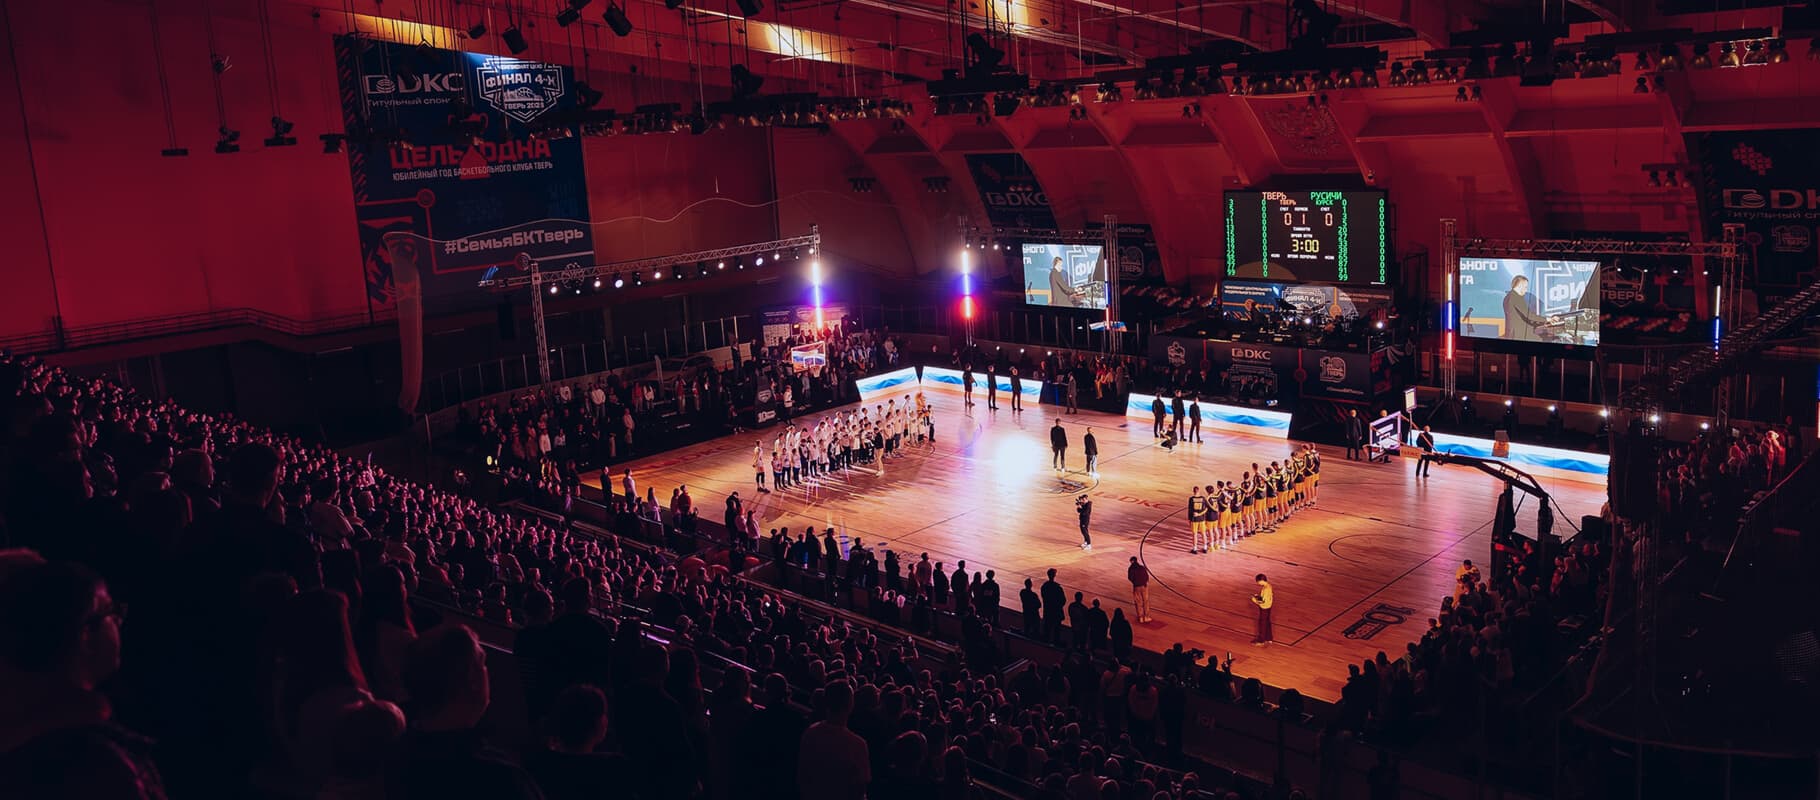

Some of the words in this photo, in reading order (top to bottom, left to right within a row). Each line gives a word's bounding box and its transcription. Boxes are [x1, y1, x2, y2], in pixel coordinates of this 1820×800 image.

[397, 73, 464, 94] DKC
[486, 73, 532, 87] ФИНАЛ
[389, 143, 464, 170] ЦЕЛЬ
[392, 169, 439, 181] ЮБИЛЕЙНЫЙ
[440, 167, 453, 177] ГОД
[454, 163, 512, 176] БАСКЕТБОЛЬНОГО
[513, 162, 533, 172] КЛУБА
[534, 160, 553, 169] ТВЕРЬ
[1006, 191, 1049, 206] DKC
[1262, 192, 1287, 200] ТВЕРЬ
[1310, 192, 1343, 200] РУСИЧИ
[1285, 213, 1292, 226] 0
[1325, 213, 1333, 226] 0
[444, 229, 585, 254] #СемьяБКТверь
[1292, 239, 1319, 253] 3:00
[1460, 274, 1474, 285] ГА
[1548, 281, 1587, 302] ФИ
[1600, 289, 1645, 303] ТВЕРЬ
[1245, 349, 1271, 360] DKC
